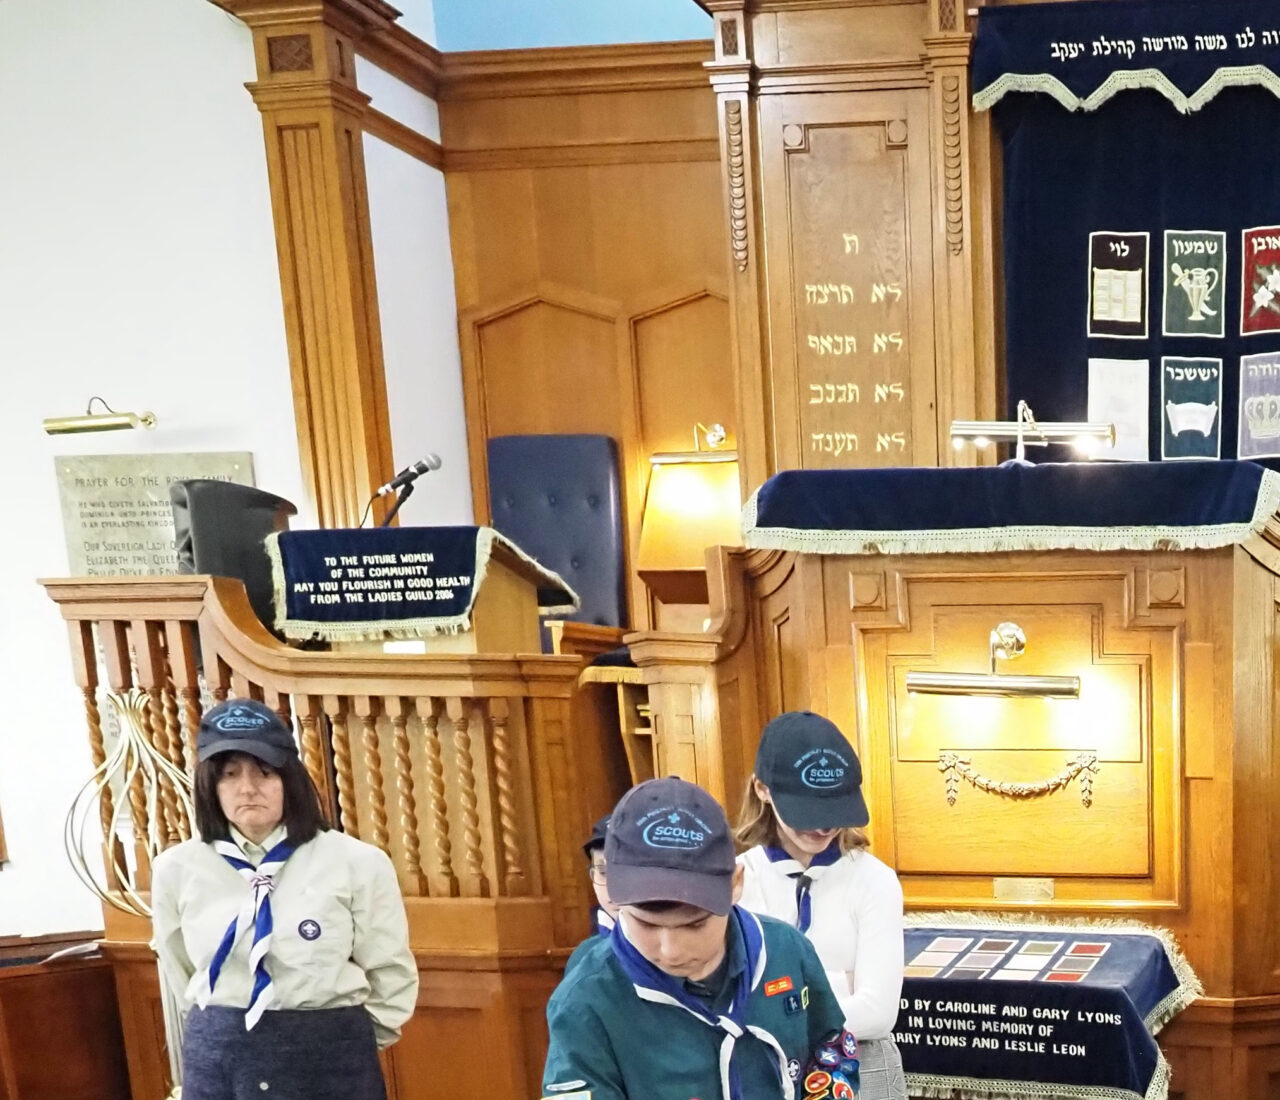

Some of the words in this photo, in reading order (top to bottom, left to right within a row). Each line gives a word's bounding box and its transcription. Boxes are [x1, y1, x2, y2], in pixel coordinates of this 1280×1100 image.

[1092, 35, 1136, 60] קהילת
[1142, 34, 1188, 51] מורשה
[1195, 34, 1227, 50] משה
[1236, 26, 1255, 48] לנו
[1051, 42, 1085, 61] יעקב
[843, 233, 859, 255] ת
[1109, 241, 1130, 257] לוי
[1172, 239, 1218, 257] שמעון
[804, 283, 854, 304] תרצח
[871, 282, 902, 303] לא
[807, 333, 857, 355] תנאף
[873, 331, 904, 353] לא
[1165, 366, 1218, 381] יששכר
[809, 382, 859, 404] תגנב
[874, 382, 904, 403] לא
[811, 432, 858, 457] תענה
[876, 432, 906, 453] לא
[75, 477, 109, 488] PRAYER
[115, 477, 134, 487] FOR
[142, 476, 159, 486] THE
[324, 556, 337, 567] TO
[341, 556, 358, 566] THE
[362, 554, 397, 565] FUTURE
[400, 553, 434, 564] WOMEN
[331, 568, 343, 579] OF
[347, 567, 365, 578] THE
[369, 565, 428, 577] COMMUNITY
[294, 582, 314, 593] MAY
[318, 581, 338, 592] YOU
[342, 579, 391, 591] FLOURISH
[394, 578, 404, 589] IN
[407, 577, 433, 589] GOOD
[436, 575, 471, 587] HEALTH
[310, 593, 341, 604] FROM
[344, 592, 364, 603] THE
[367, 591, 403, 603] LADIES
[405, 590, 434, 601] GUILD
[914, 998, 931, 1011] BY
[936, 1000, 997, 1015] CAROLINE
[1001, 1005, 1028, 1018] AND
[1032, 1007, 1070, 1022] GARY
[1077, 1010, 1122, 1026] LYONS
[908, 1015, 924, 1028] IN
[928, 1016, 976, 1031] LOVING
[981, 1020, 1034, 1036] MEMORY
[1038, 1024, 1054, 1037] OF
[890, 1031, 921, 1045] ARRY
[926, 1034, 967, 1047] LYONS
[972, 1037, 999, 1050] AND
[1004, 1039, 1046, 1054] LESLIE
[1052, 1043, 1086, 1057] LEON
